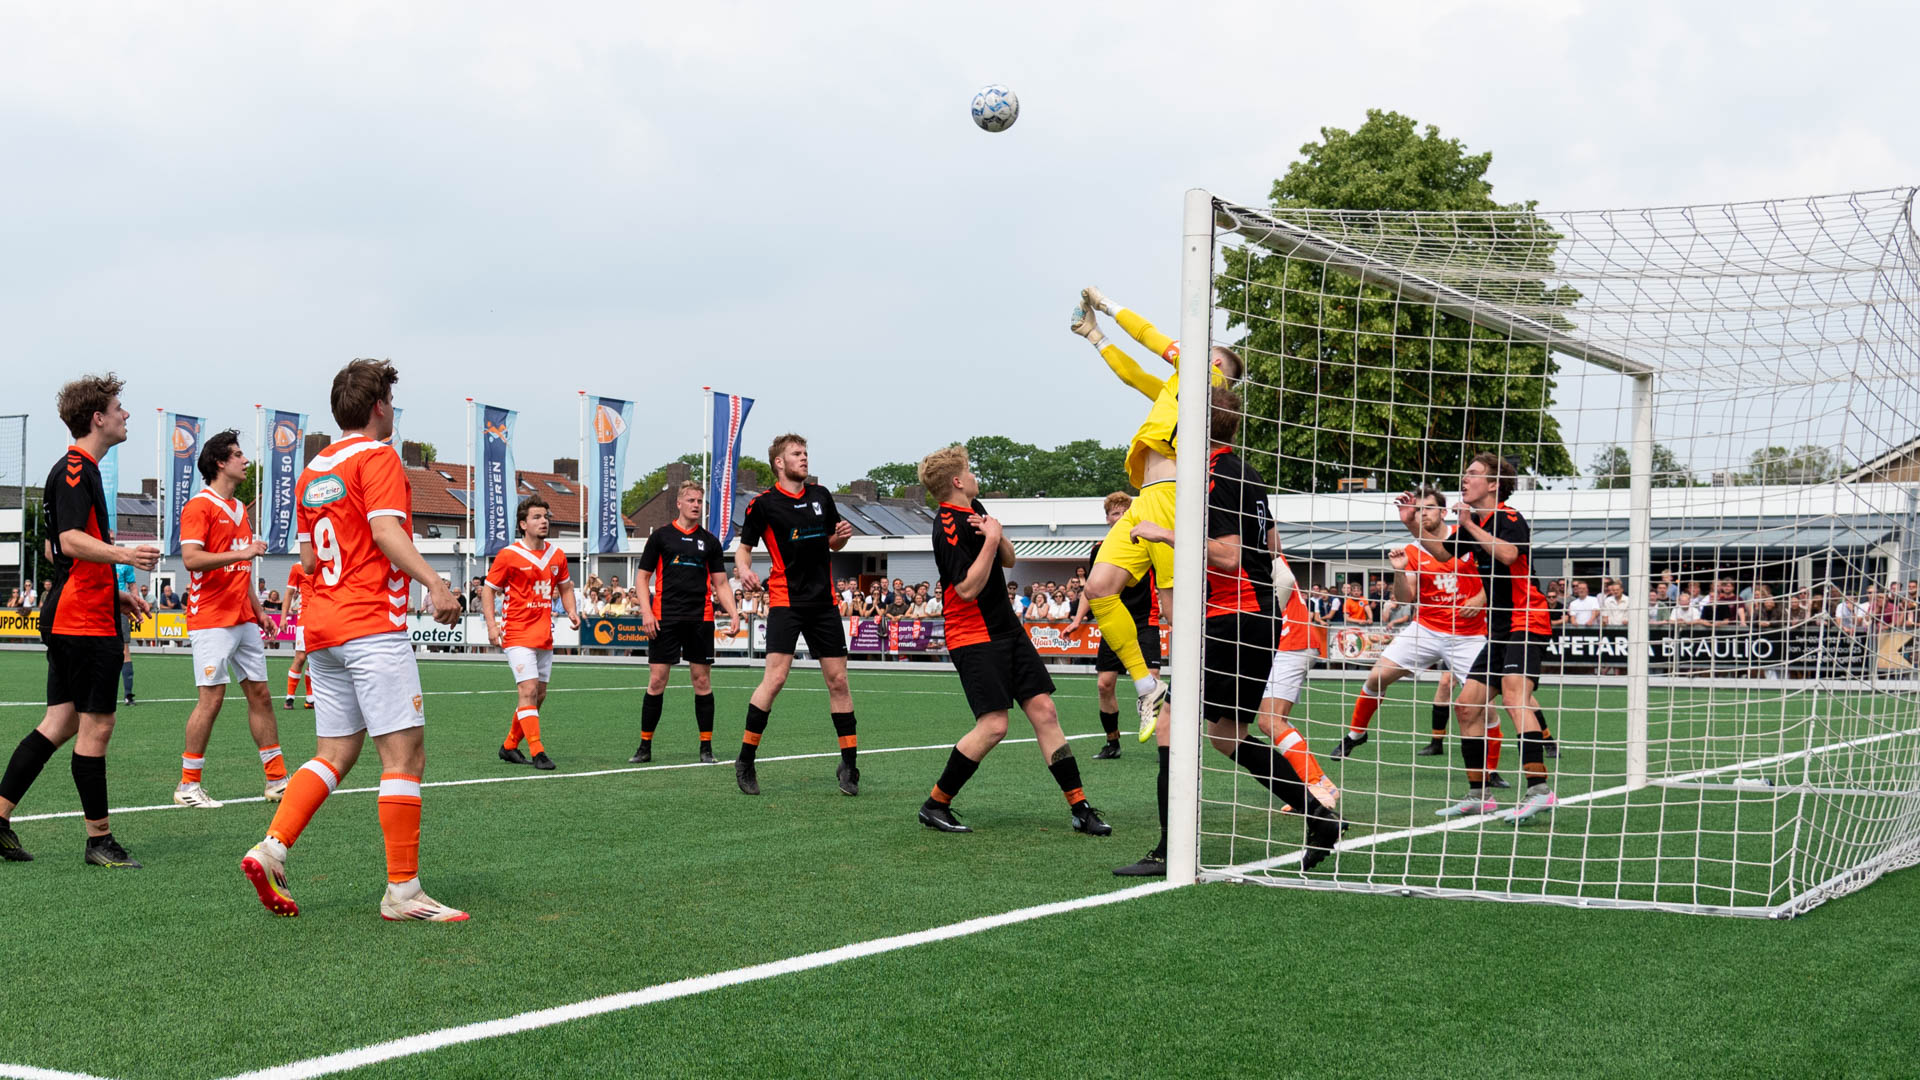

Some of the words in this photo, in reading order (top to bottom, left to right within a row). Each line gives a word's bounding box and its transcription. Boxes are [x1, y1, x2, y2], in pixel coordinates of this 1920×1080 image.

[282, 455, 293, 473] 50
[280, 480, 291, 507] VAN
[492, 461, 506, 541] ANGEREN
[608, 455, 617, 537] ANGEREN
[279, 511, 290, 548] CLUB
[314, 516, 342, 586] 9
[159, 626, 183, 636] VAN
[408, 628, 463, 642] oeters
[617, 624, 636, 632] Guus
[1031, 626, 1060, 637] Design
[1546, 636, 1655, 656] AFETAR
[1661, 637, 1774, 659] BRAULIO
